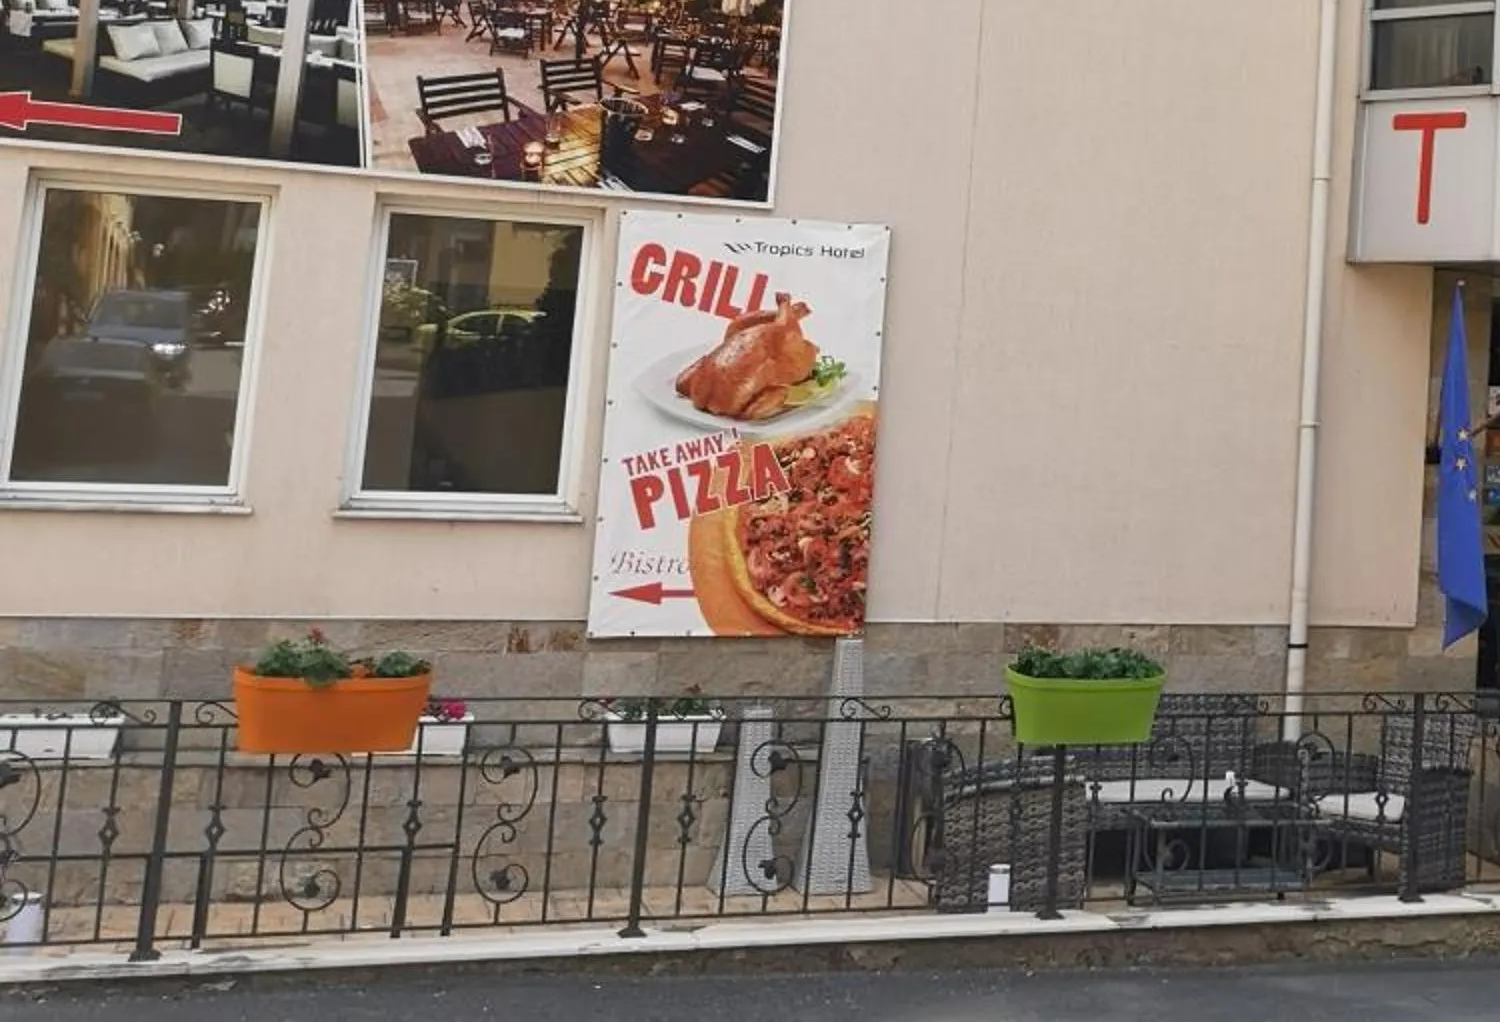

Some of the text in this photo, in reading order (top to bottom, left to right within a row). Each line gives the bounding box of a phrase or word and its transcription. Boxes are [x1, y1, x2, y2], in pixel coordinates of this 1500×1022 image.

[754, 241, 865, 259] Tropics Hotel
[622, 448, 673, 477] TAKE
[629, 442, 791, 531] PIZZA
